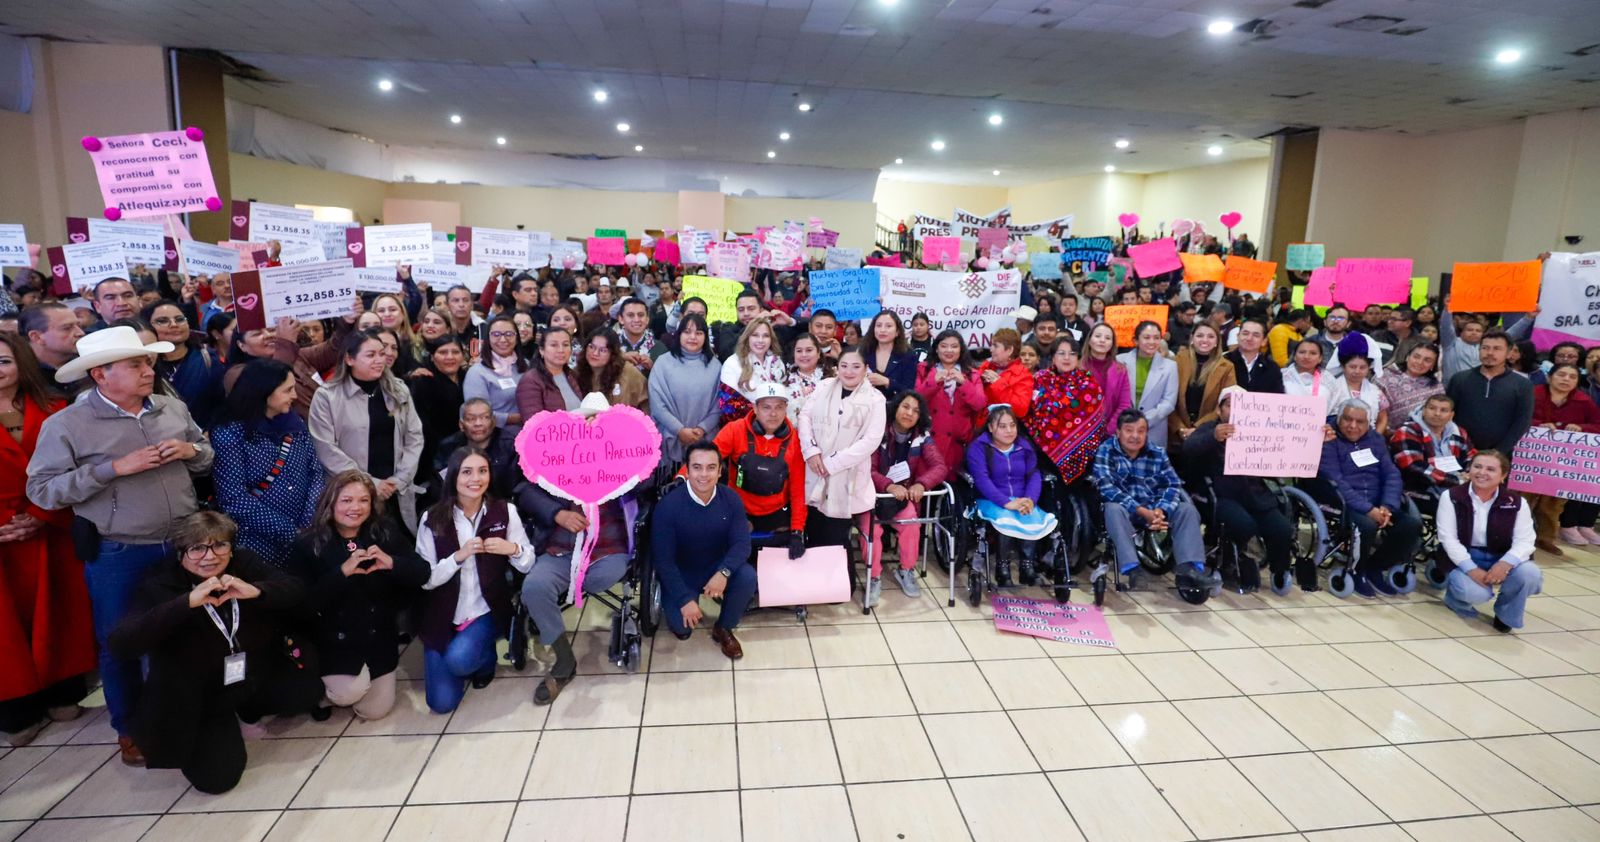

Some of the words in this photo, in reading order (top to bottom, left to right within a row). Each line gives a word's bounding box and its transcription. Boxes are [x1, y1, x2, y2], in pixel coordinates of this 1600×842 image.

[108, 139, 144, 149] Señora
[152, 137, 187, 148] Ceci,
[101, 154, 170, 166] reconocemos
[179, 152, 198, 160] con
[115, 169, 155, 181] gratitud
[110, 183, 173, 194] compromiso
[118, 196, 204, 211] Atlequizayán
[271, 224, 311, 235] 32,858.35
[388, 243, 430, 253] 32,858.35
[491, 248, 526, 257] 32,858.35
[88, 262, 124, 274] 32,858.35
[811, 271, 839, 280] Muchas
[996, 272, 1011, 281] DIF
[285, 296, 292, 305] $
[296, 287, 352, 304] 32,858.35
[917, 305, 939, 316] Sra.
[943, 305, 969, 316] Ceci
[971, 304, 1015, 316] Arellano
[946, 320, 986, 330] APOYO
[1554, 315, 1583, 327] SRA.
[535, 422, 605, 443] GRACIAS
[1573, 448, 1598, 459] CECI
[1557, 456, 1578, 467] POR
[1584, 461, 1597, 470] EL
[1533, 466, 1546, 475] DE
[1548, 469, 1560, 477] LA
[1515, 474, 1532, 483] DIA
[1054, 603, 1071, 611] POR
[995, 613, 1048, 624] NUESTROS
[1016, 622, 1069, 634] APARATOS
